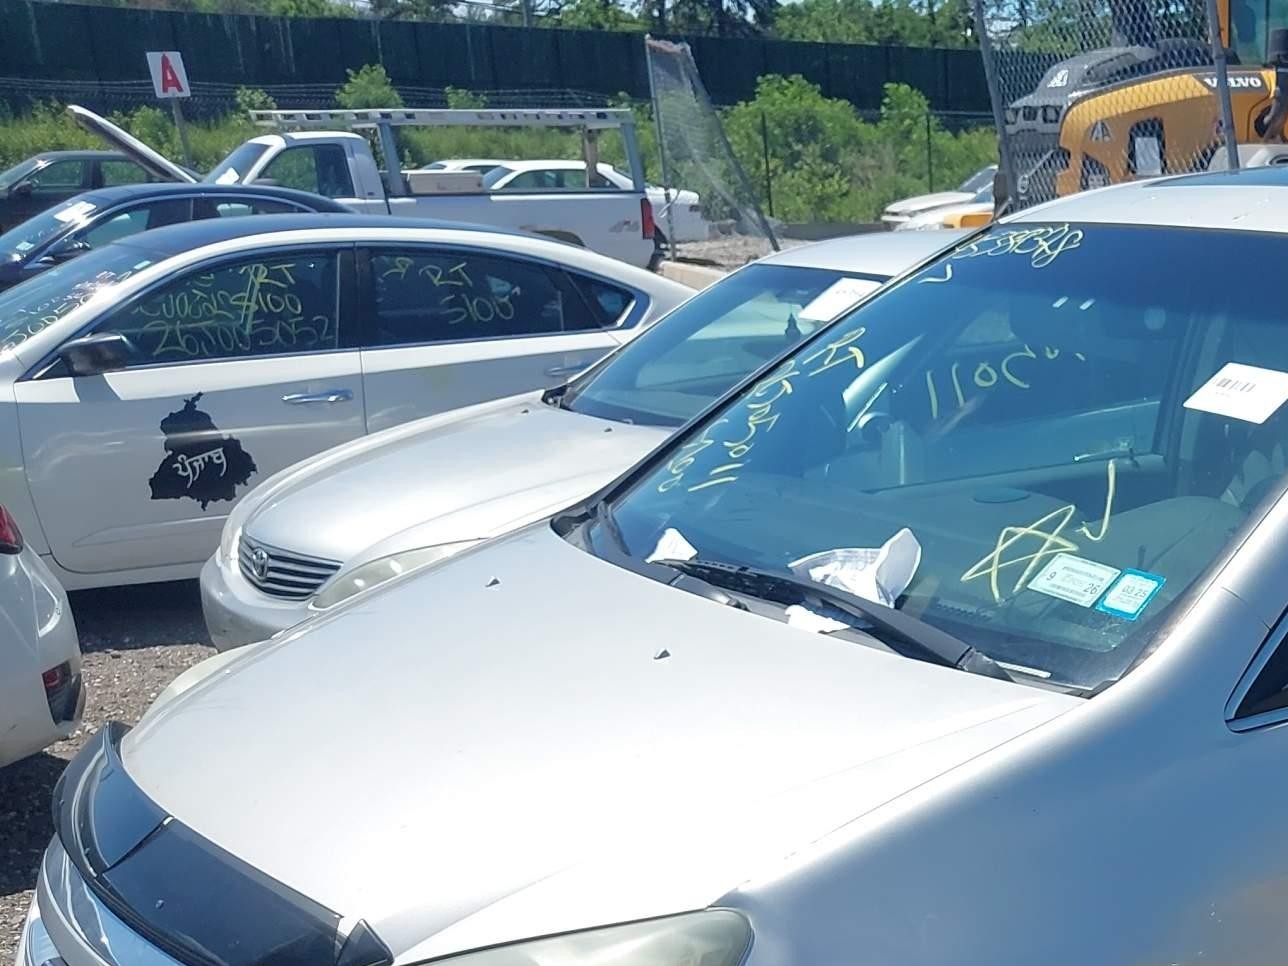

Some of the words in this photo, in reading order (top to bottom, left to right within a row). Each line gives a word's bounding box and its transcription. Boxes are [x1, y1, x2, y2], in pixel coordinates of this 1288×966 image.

[161, 53, 184, 94] A
[1203, 76, 1262, 88] VLVO
[418, 261, 473, 287] RT
